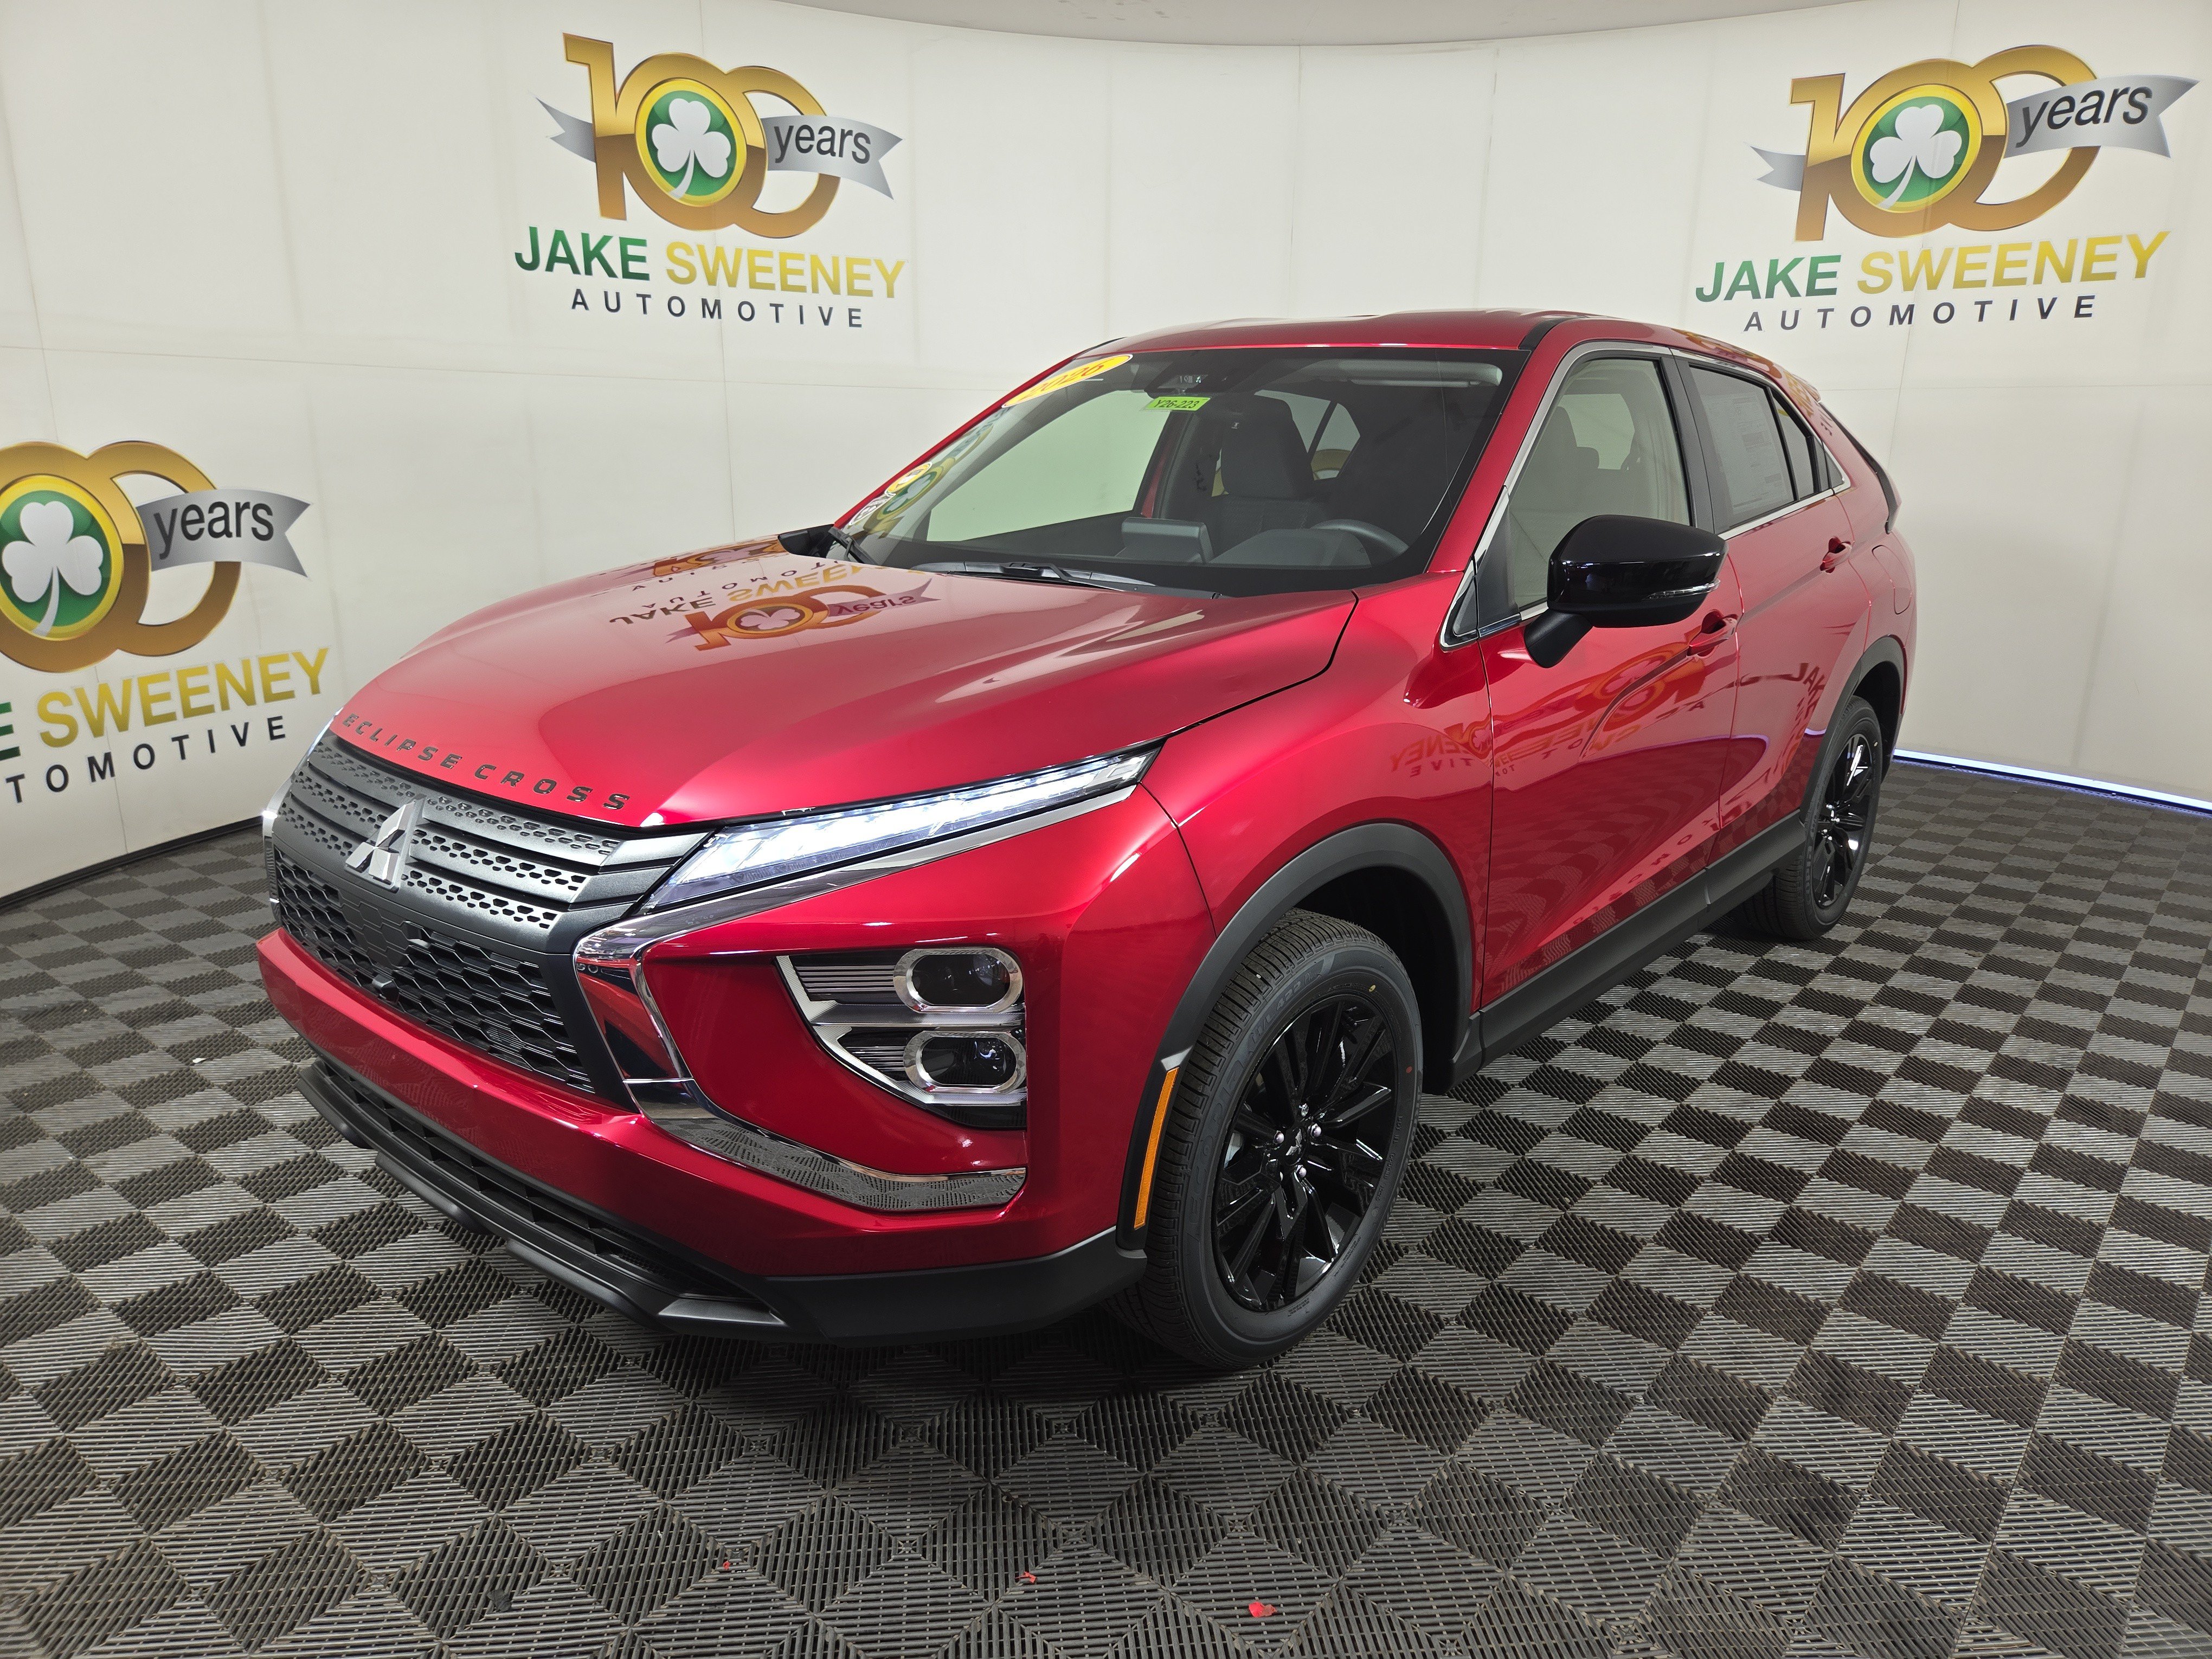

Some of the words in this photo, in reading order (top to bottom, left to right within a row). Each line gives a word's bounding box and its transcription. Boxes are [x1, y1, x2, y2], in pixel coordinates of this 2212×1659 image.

[774, 124, 871, 165] years
[2015, 86, 2152, 148] years
[515, 226, 651, 281] JAKE
[666, 241, 906, 299] SWEENEY
[1695, 254, 1842, 303] JAKE
[1856, 230, 2171, 294] SWEENEY
[571, 288, 863, 328] AUTOMOTIVE
[1744, 295, 2095, 332] AUTOMOTIVE
[1154, 398, 1200, 409] Y26-223
[155, 501, 275, 560] years
[37, 648, 330, 748] SWEENEY
[6, 716, 286, 803] TOMOTIVE
[342, 713, 463, 770] ECLIPSE
[474, 764, 630, 811] CROSS
